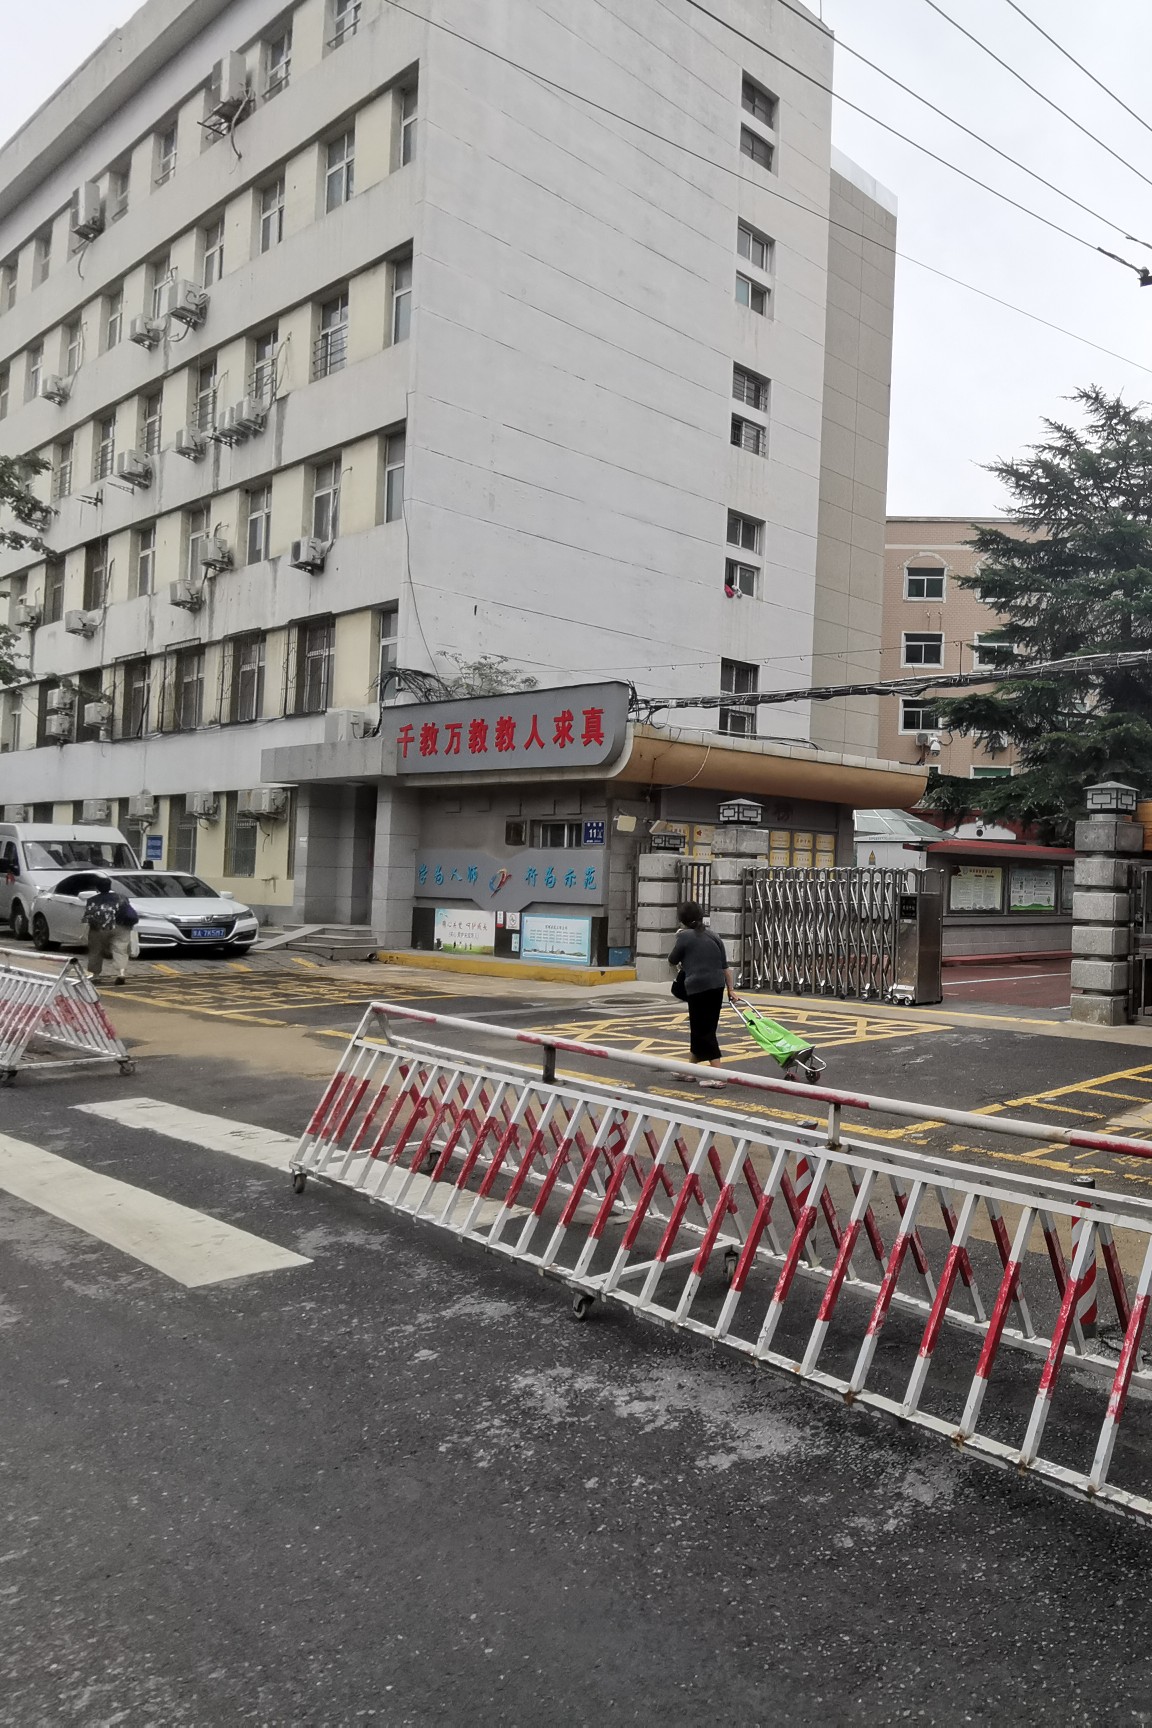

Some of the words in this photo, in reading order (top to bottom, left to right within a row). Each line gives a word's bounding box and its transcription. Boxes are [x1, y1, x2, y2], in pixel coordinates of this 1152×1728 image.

[397, 706, 605, 758] 千教万教教人求真
[589, 828, 597, 838] 11
[418, 863, 478, 886] 学为人师
[524, 865, 597, 890] 行为示范
